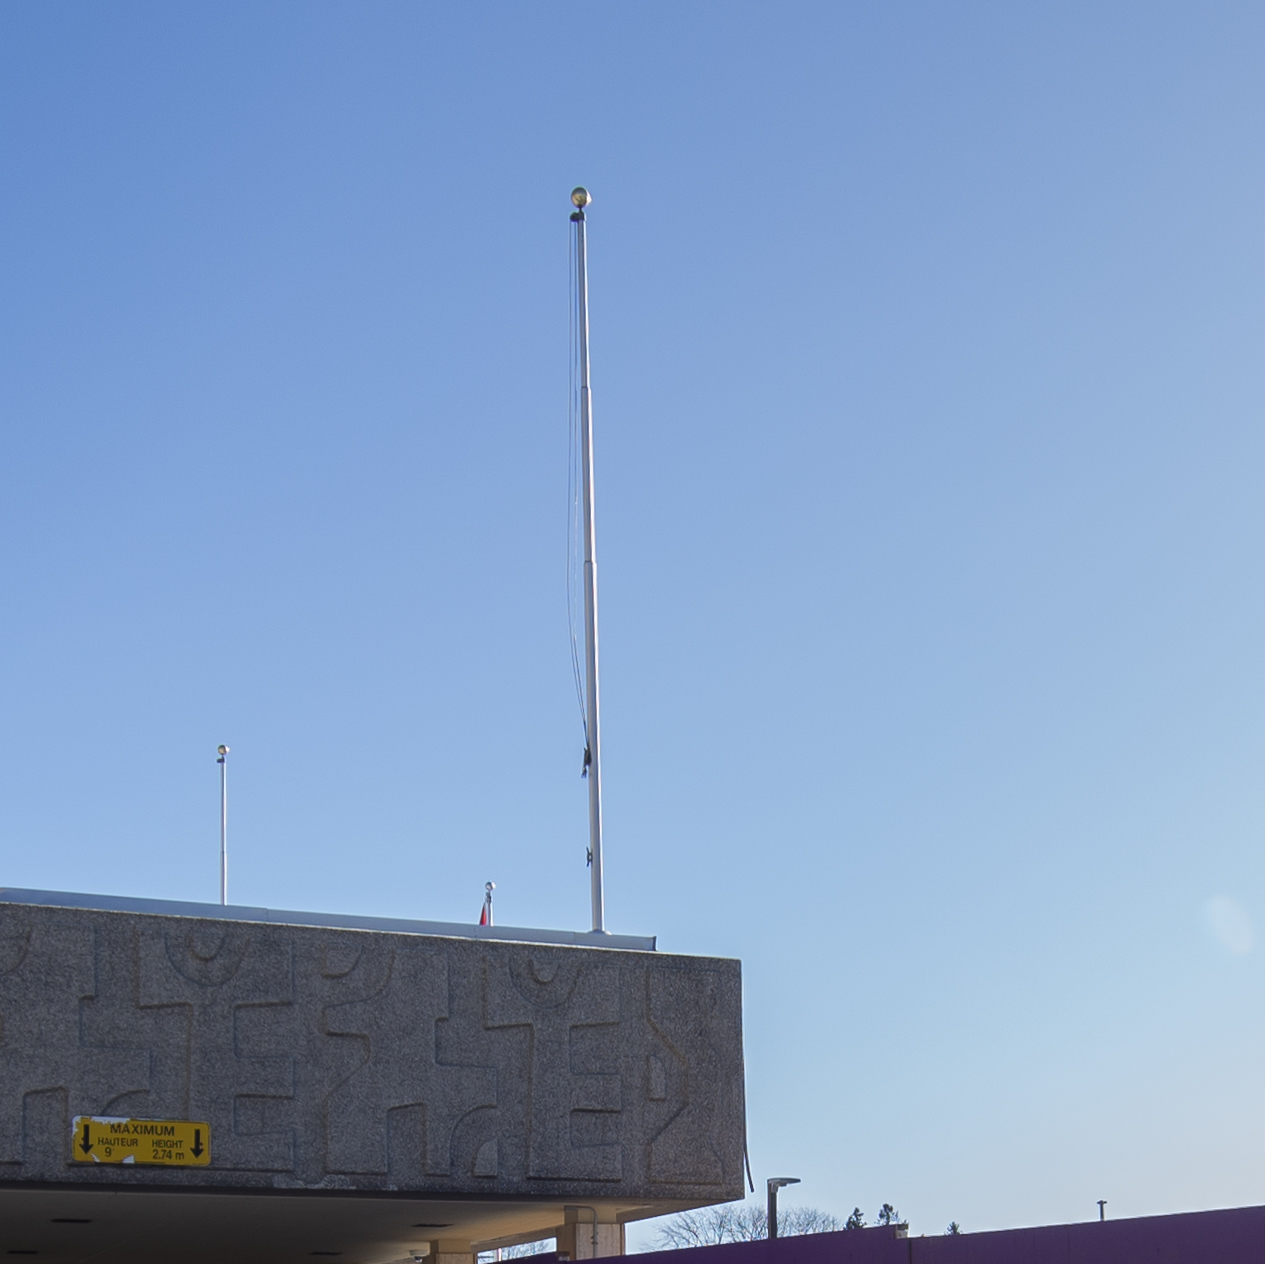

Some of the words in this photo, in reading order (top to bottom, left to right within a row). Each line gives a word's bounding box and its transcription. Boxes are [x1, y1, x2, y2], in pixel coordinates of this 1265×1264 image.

[110, 1124, 174, 1136] MAXIMUM
[97, 1136, 139, 1148] HAUTEUR
[151, 1139, 184, 1150] HEIGHT
[152, 1149, 173, 1160] 2.74
[175, 1152, 185, 1160] m
